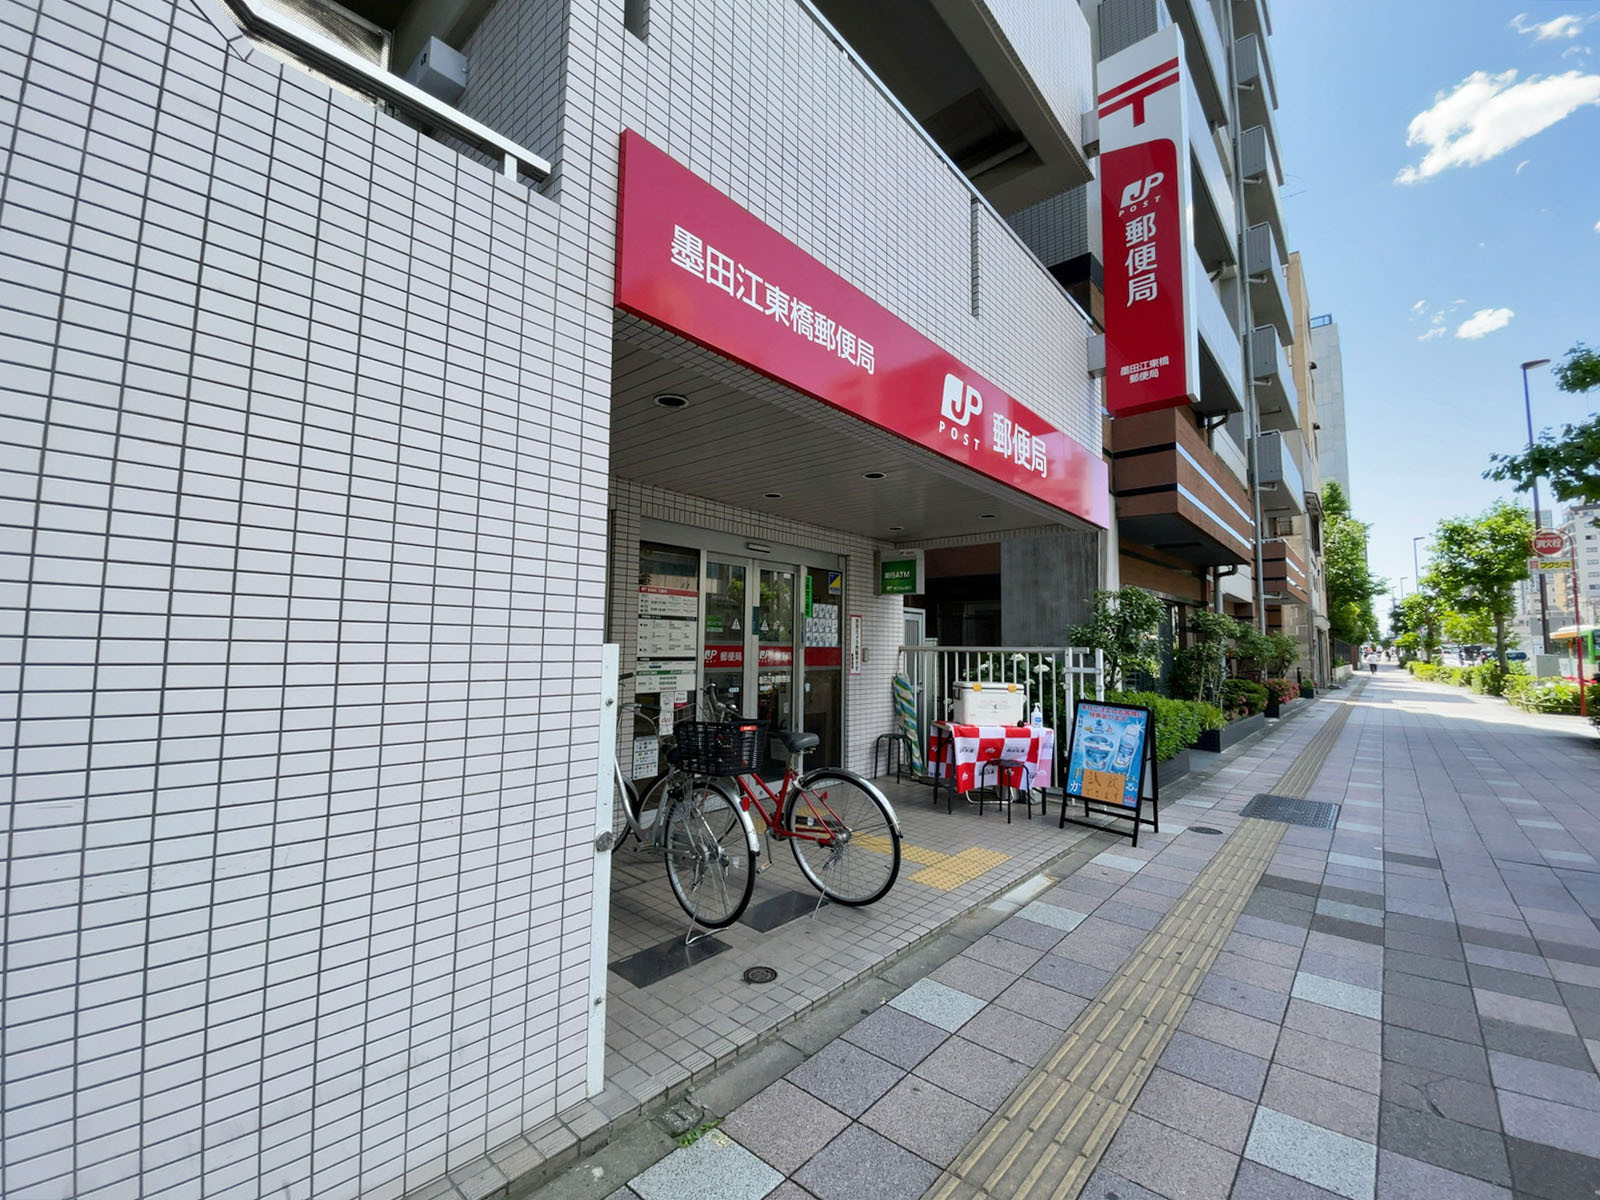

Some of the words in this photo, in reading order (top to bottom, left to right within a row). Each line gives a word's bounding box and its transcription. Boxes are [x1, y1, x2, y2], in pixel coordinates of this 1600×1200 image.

[1118, 195, 1161, 217] POST
[1125, 211, 1158, 308] 郵便局
[671, 224, 875, 375] 墨田江東橋郵便局
[1129, 368, 1159, 384] 郵便局
[939, 420, 980, 451] POST
[993, 412, 1047, 478] 郵便局
